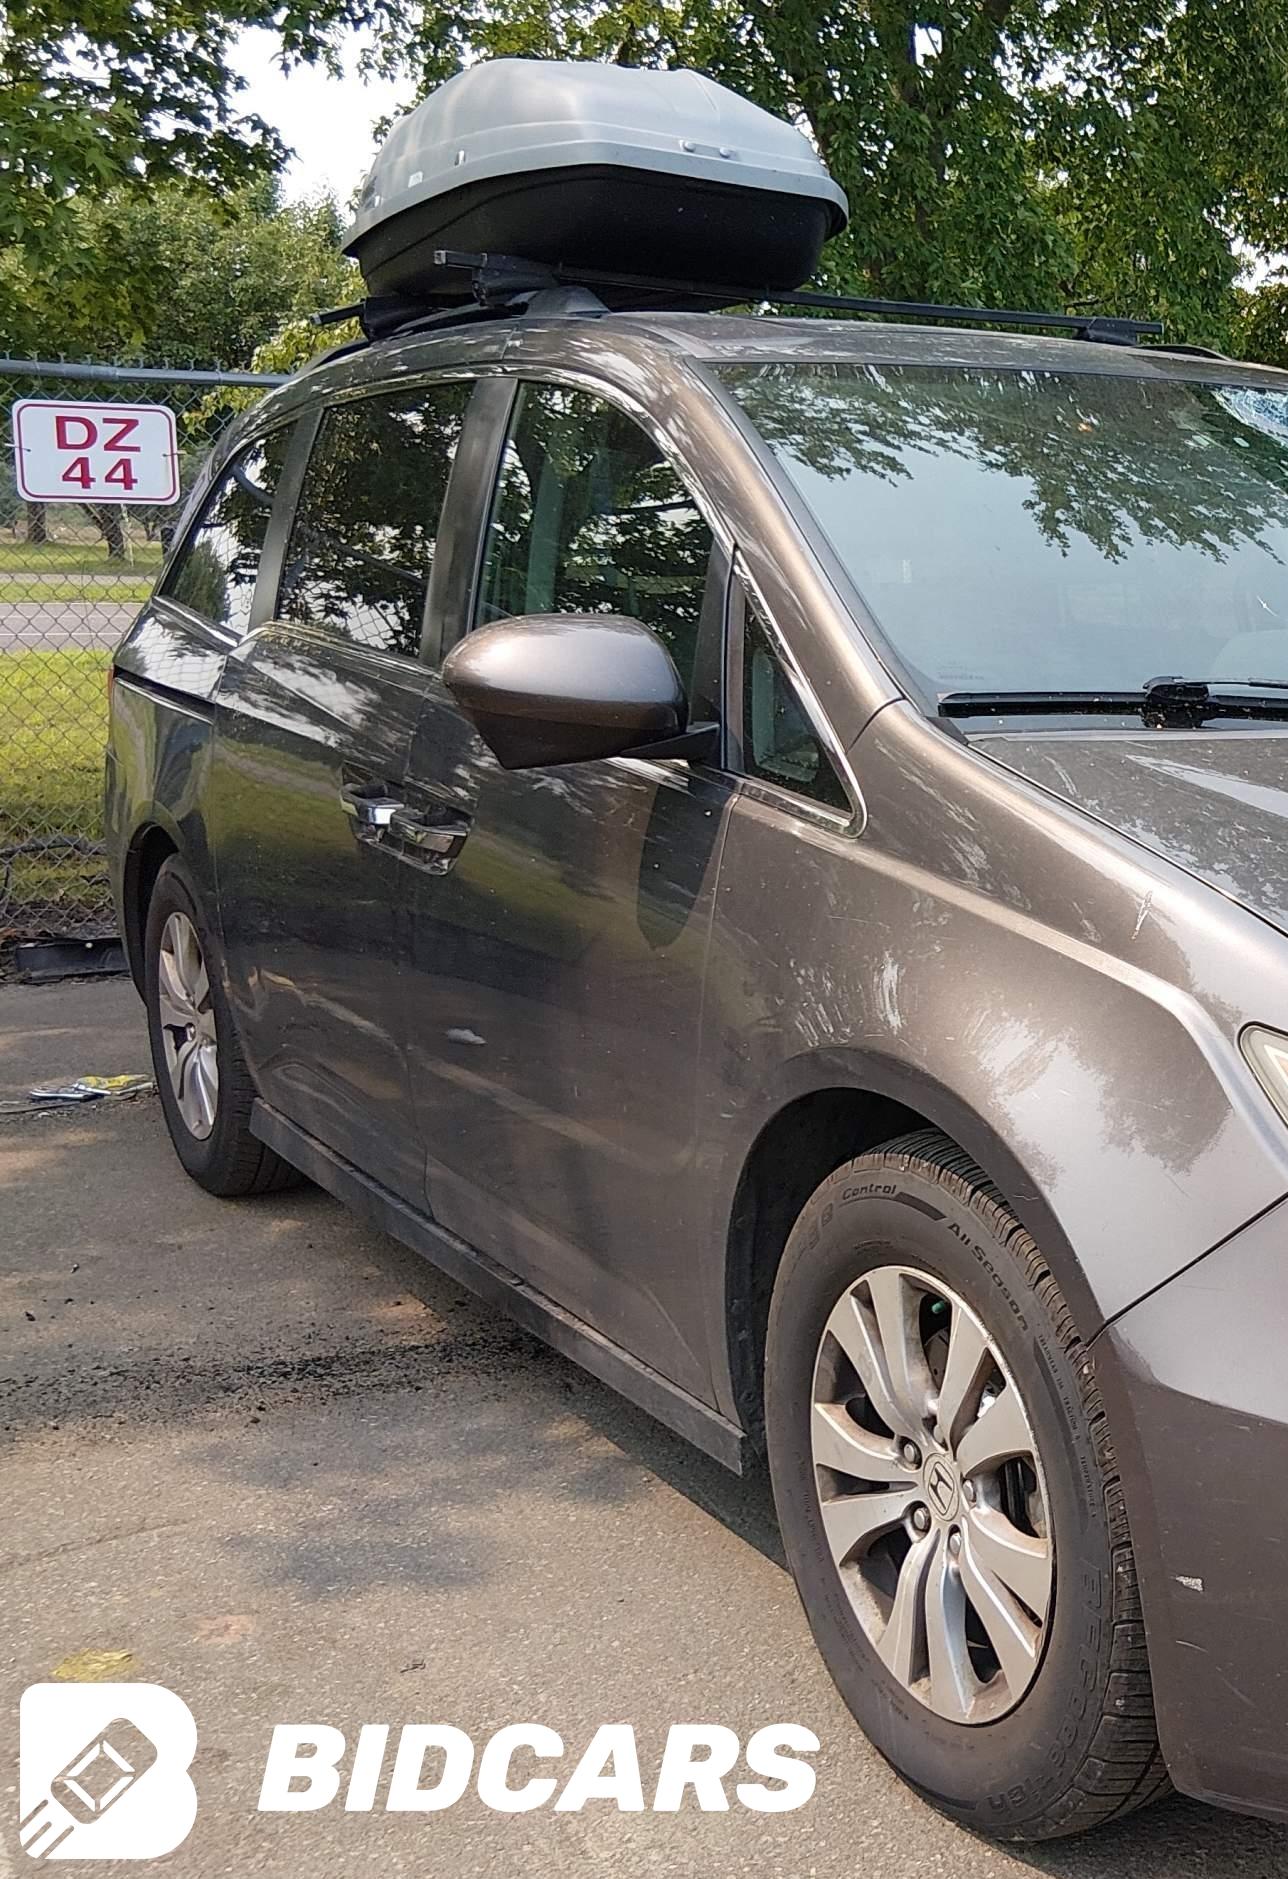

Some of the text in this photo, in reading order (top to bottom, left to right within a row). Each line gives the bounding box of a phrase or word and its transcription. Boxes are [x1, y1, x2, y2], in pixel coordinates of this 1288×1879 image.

[55, 415, 142, 453] DZ
[62, 456, 139, 491] 44
[842, 1183, 897, 1201] Control
[947, 1222, 971, 1247] All
[971, 1244, 1029, 1332] Season
